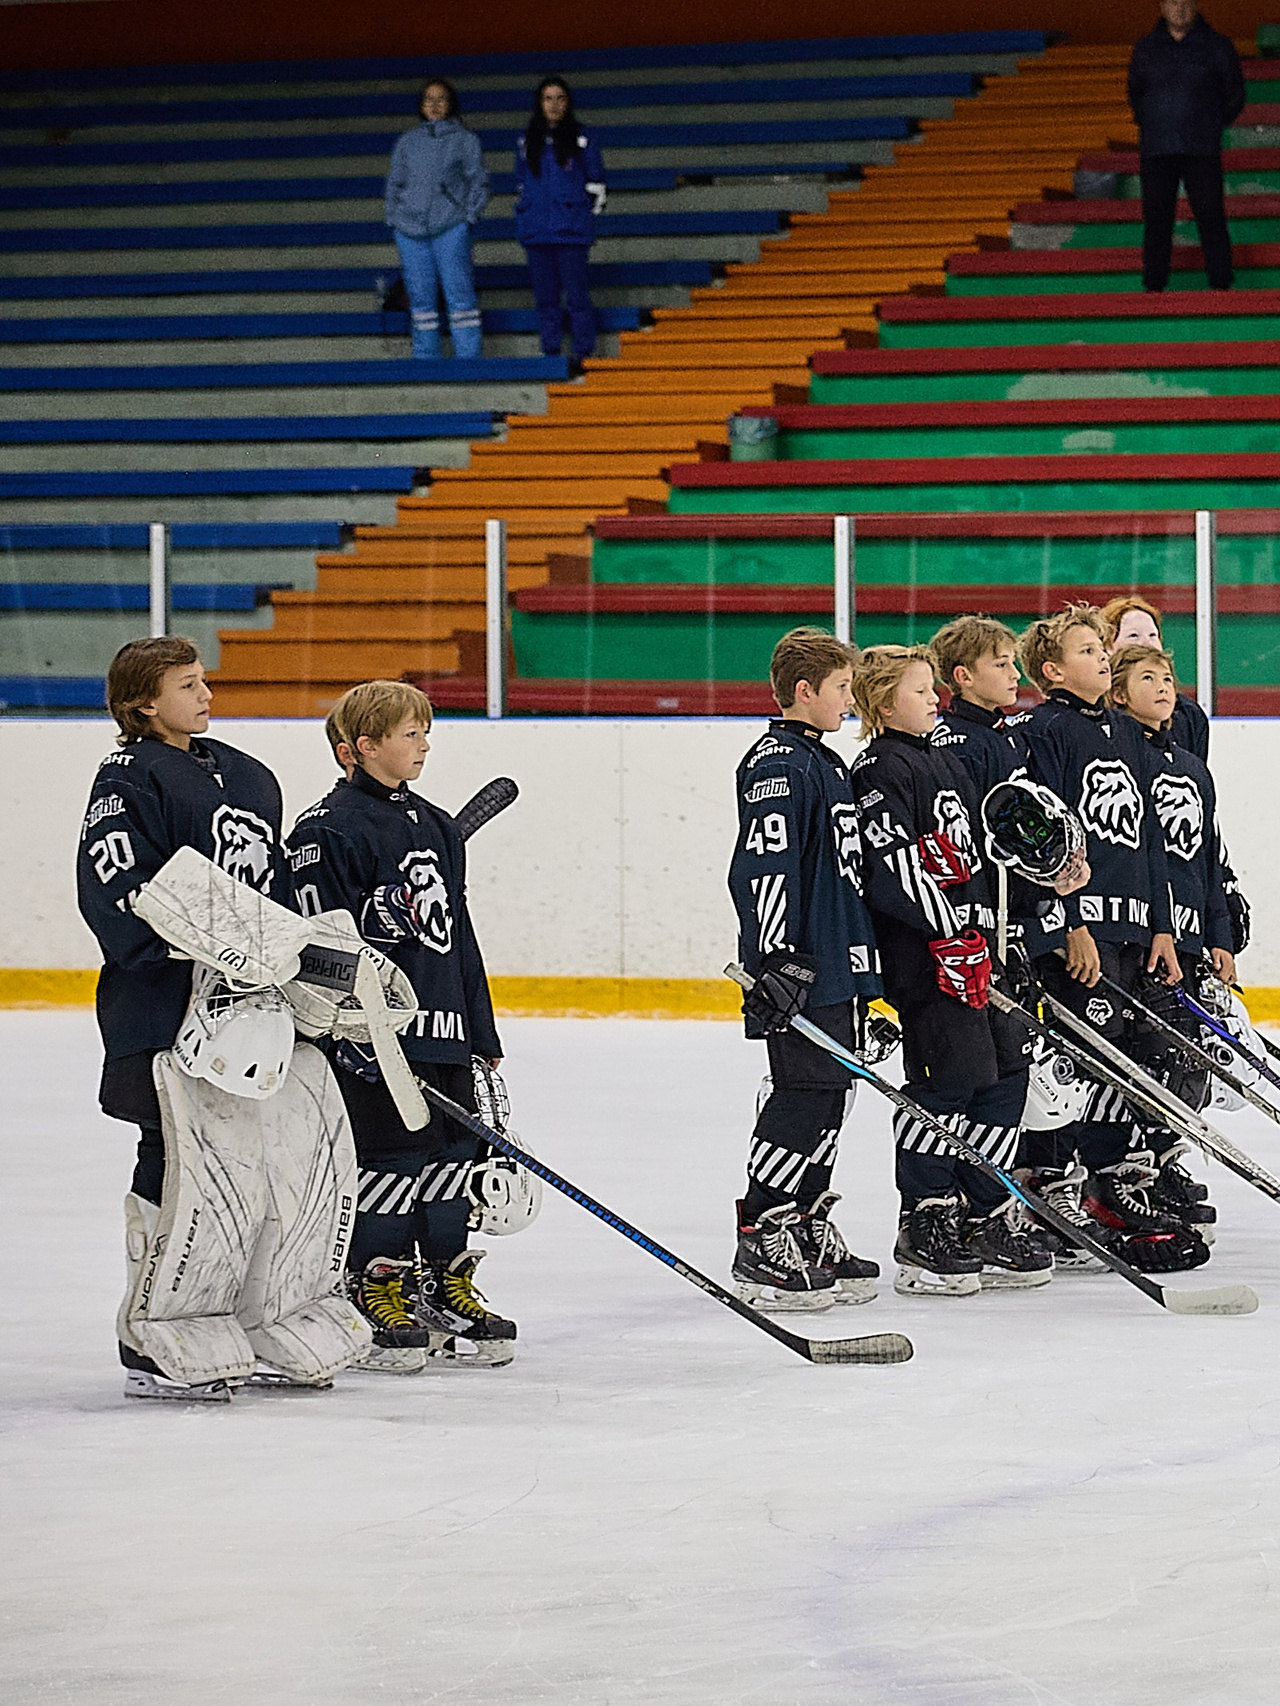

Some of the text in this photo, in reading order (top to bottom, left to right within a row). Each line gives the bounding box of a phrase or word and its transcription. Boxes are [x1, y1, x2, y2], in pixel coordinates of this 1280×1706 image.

[87, 830, 136, 885] 20
[745, 812, 789, 856] 49
[302, 955, 354, 982] SUPRE
[136, 1232, 168, 1313] VAPOR
